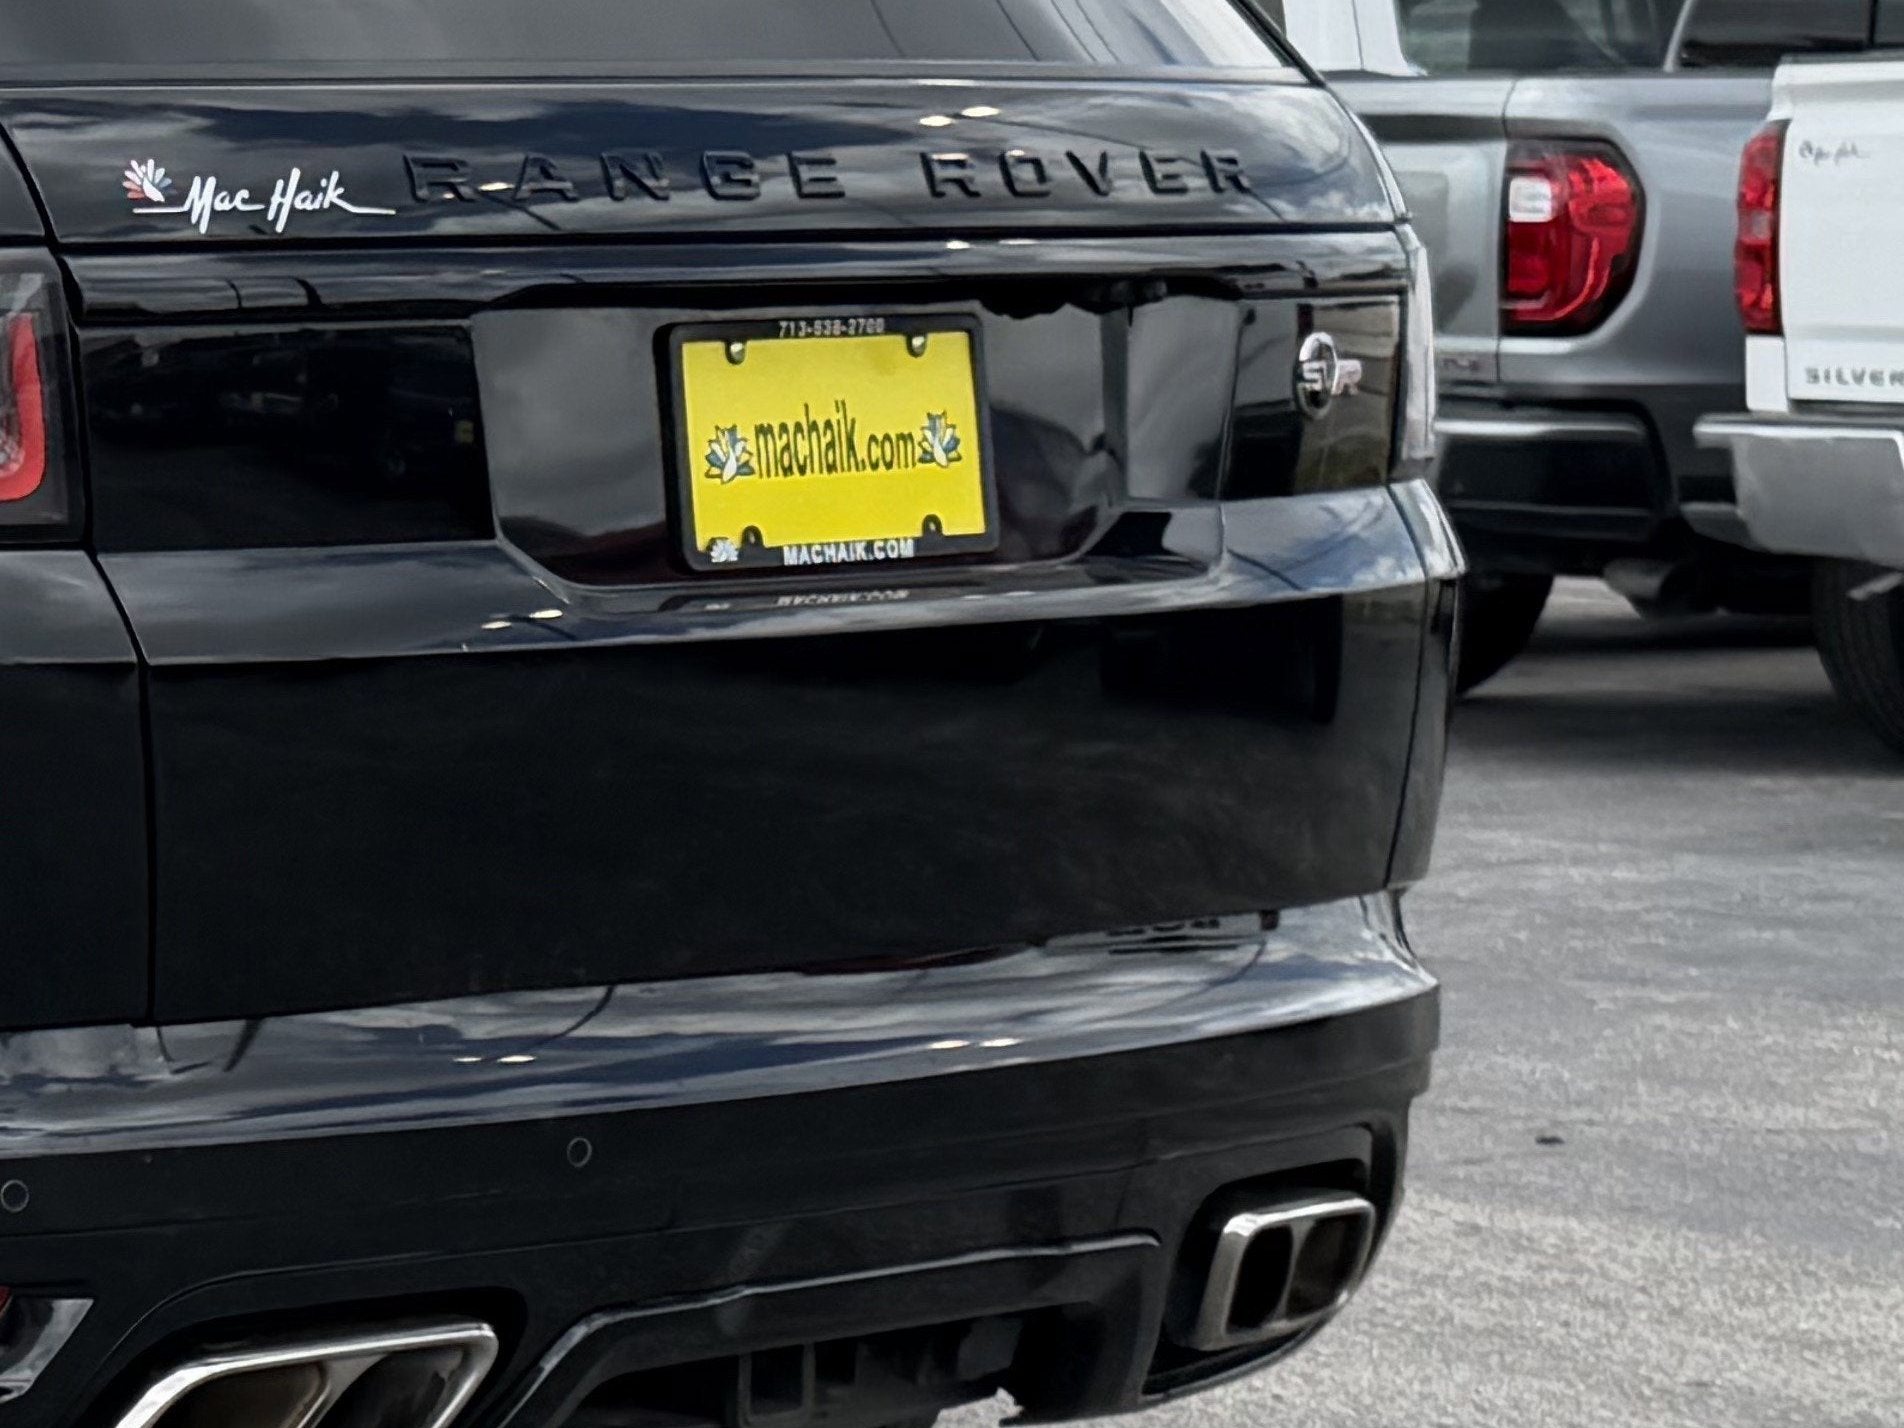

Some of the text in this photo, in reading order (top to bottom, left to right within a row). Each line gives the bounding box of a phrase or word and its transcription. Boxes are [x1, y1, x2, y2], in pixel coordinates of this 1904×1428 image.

[137, 168, 396, 234] Mac Haik
[402, 146, 1255, 203] RANGE ROVER
[754, 399, 917, 479] machaik.com
[783, 538, 915, 566] MACHAIK.COM
